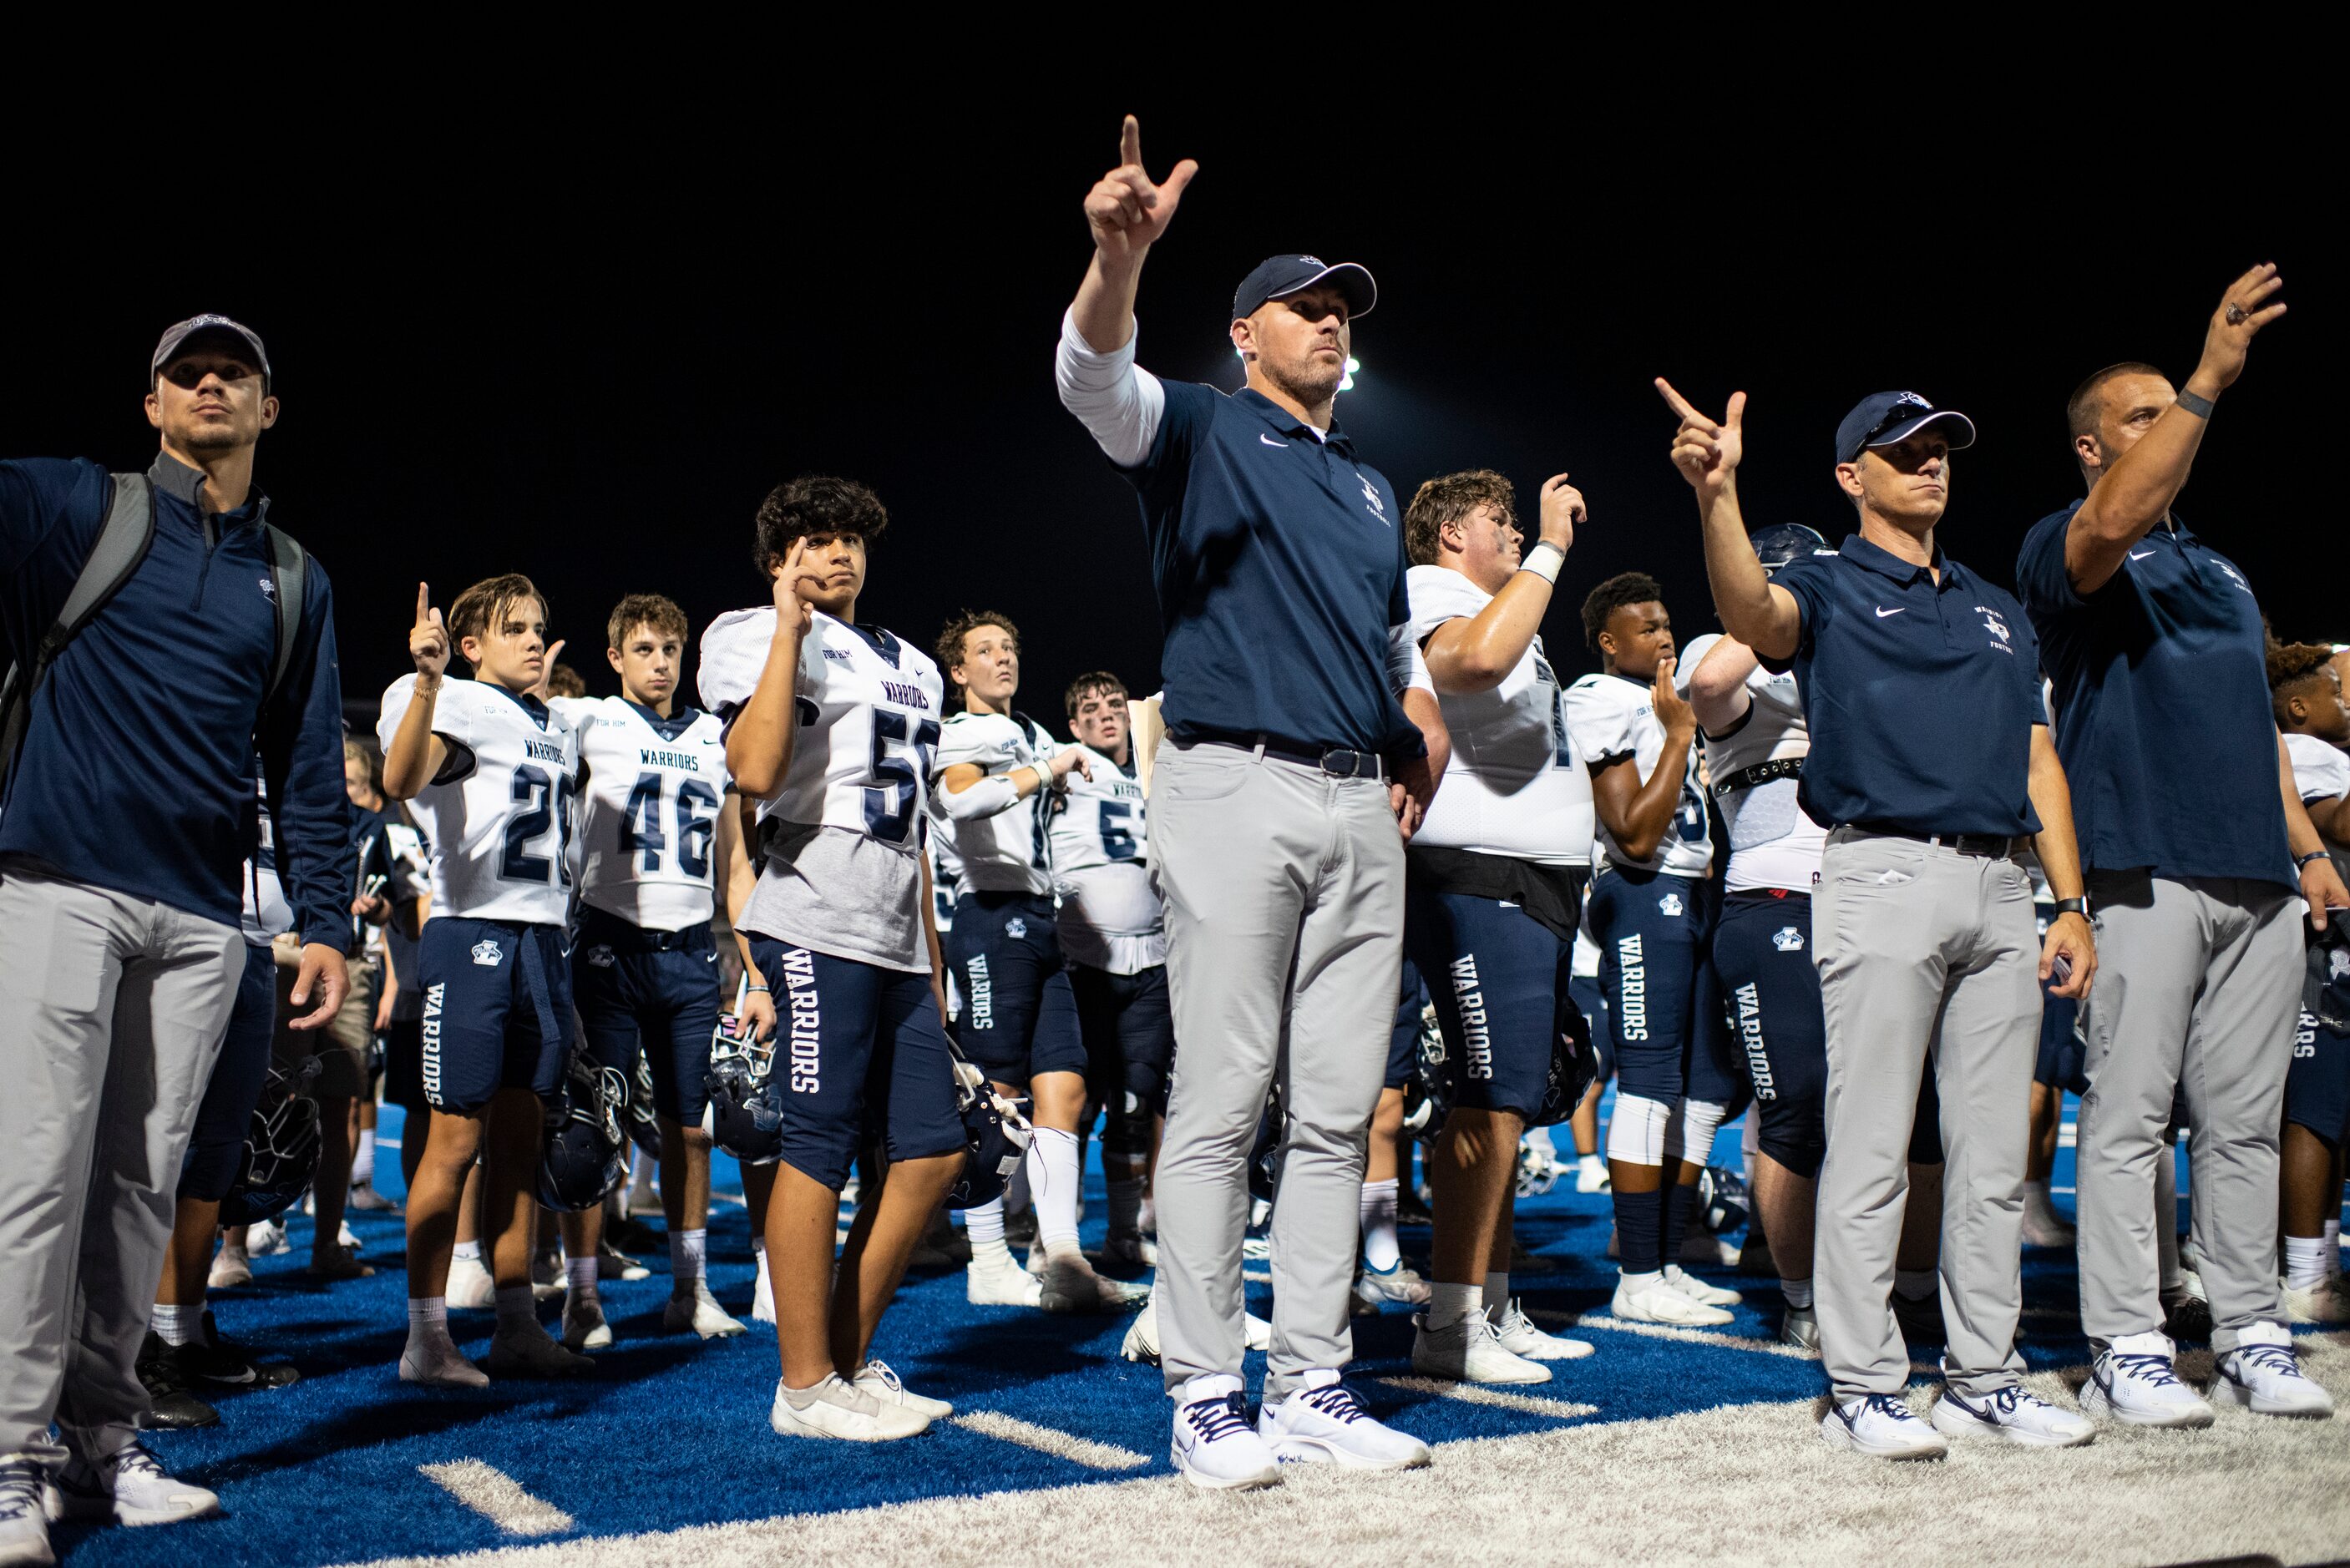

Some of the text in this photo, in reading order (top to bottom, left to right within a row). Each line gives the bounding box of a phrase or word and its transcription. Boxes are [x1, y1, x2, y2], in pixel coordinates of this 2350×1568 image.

[822, 649, 853, 660] FOR HIM
[880, 680, 929, 710] WARRIORS
[524, 738, 566, 766] WARRIORS
[596, 718, 626, 727] FOR HIM
[641, 749, 699, 771] WARRIORS
[617, 769, 720, 882] 46
[782, 948, 820, 1095] WARRIORS
[1449, 953, 1493, 1080] WARRIORS
[1618, 933, 1649, 1042] WARRIORS
[1735, 982, 1778, 1101] WARRIORS
[423, 982, 446, 1106] WARRIORS
